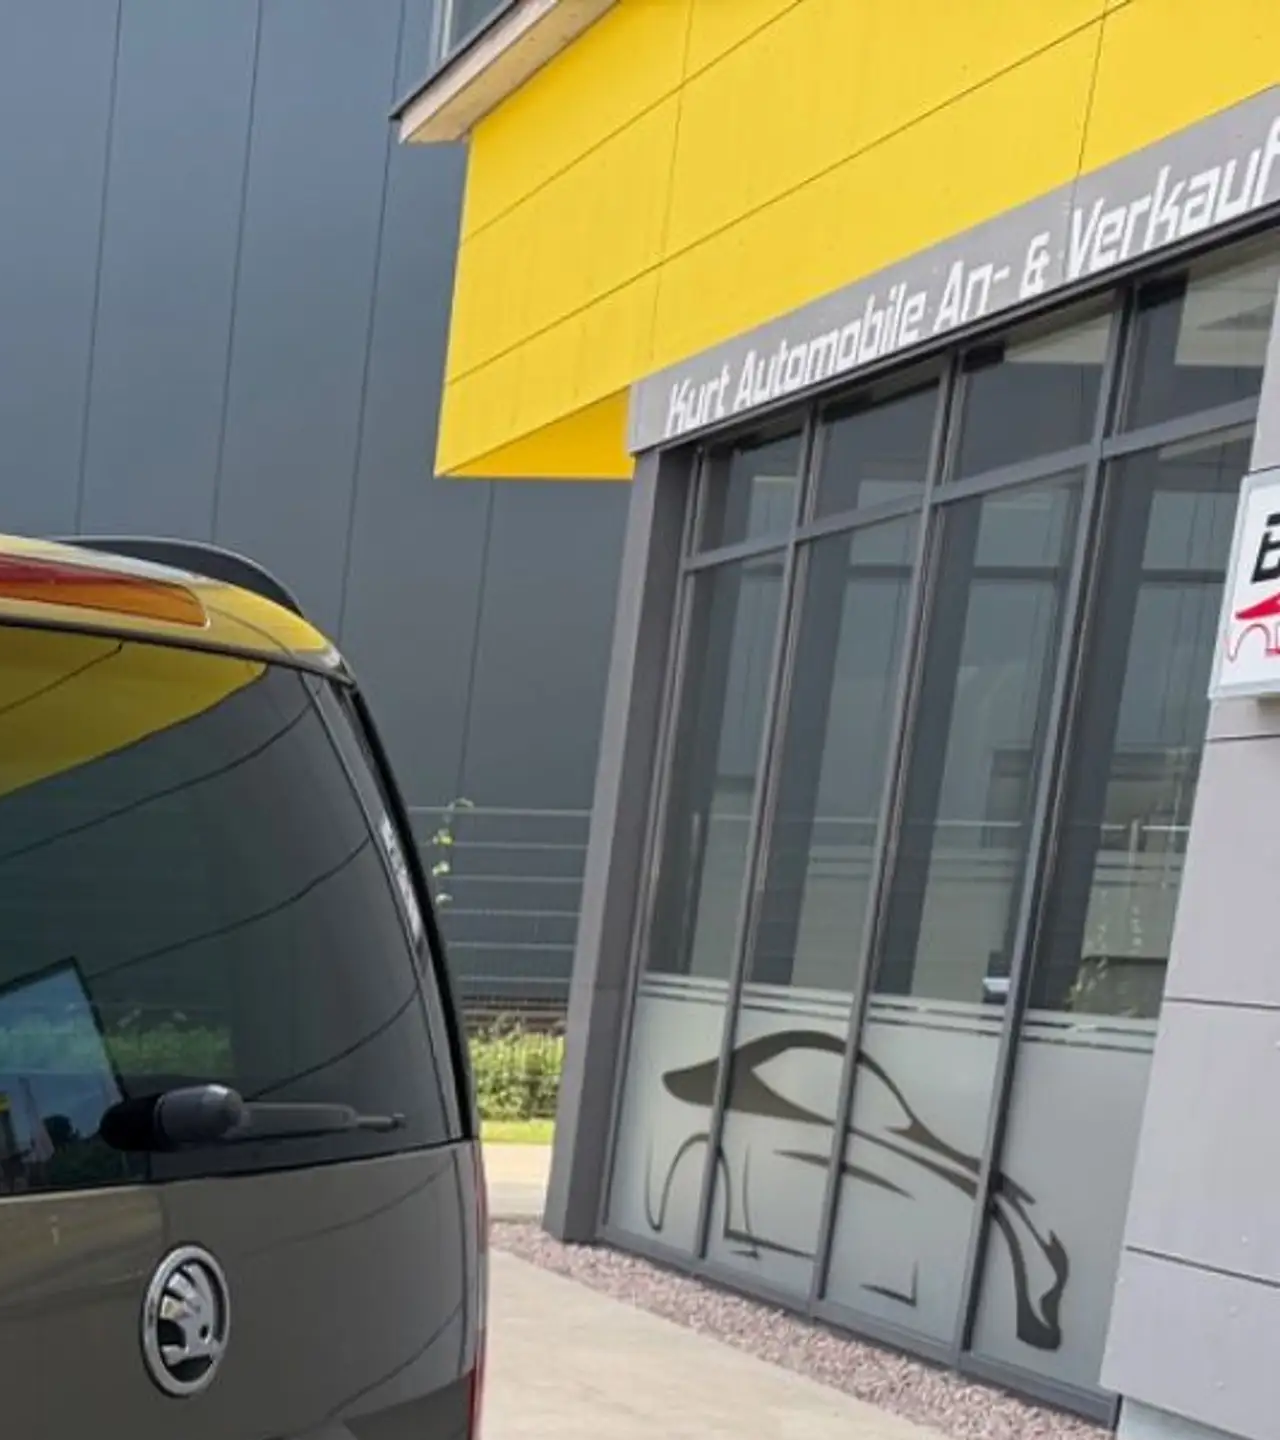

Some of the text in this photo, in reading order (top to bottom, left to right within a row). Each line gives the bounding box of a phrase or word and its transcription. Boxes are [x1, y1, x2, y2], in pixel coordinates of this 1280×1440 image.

[665, 115, 1280, 438] Kurt Automobile An- & Verkauf
